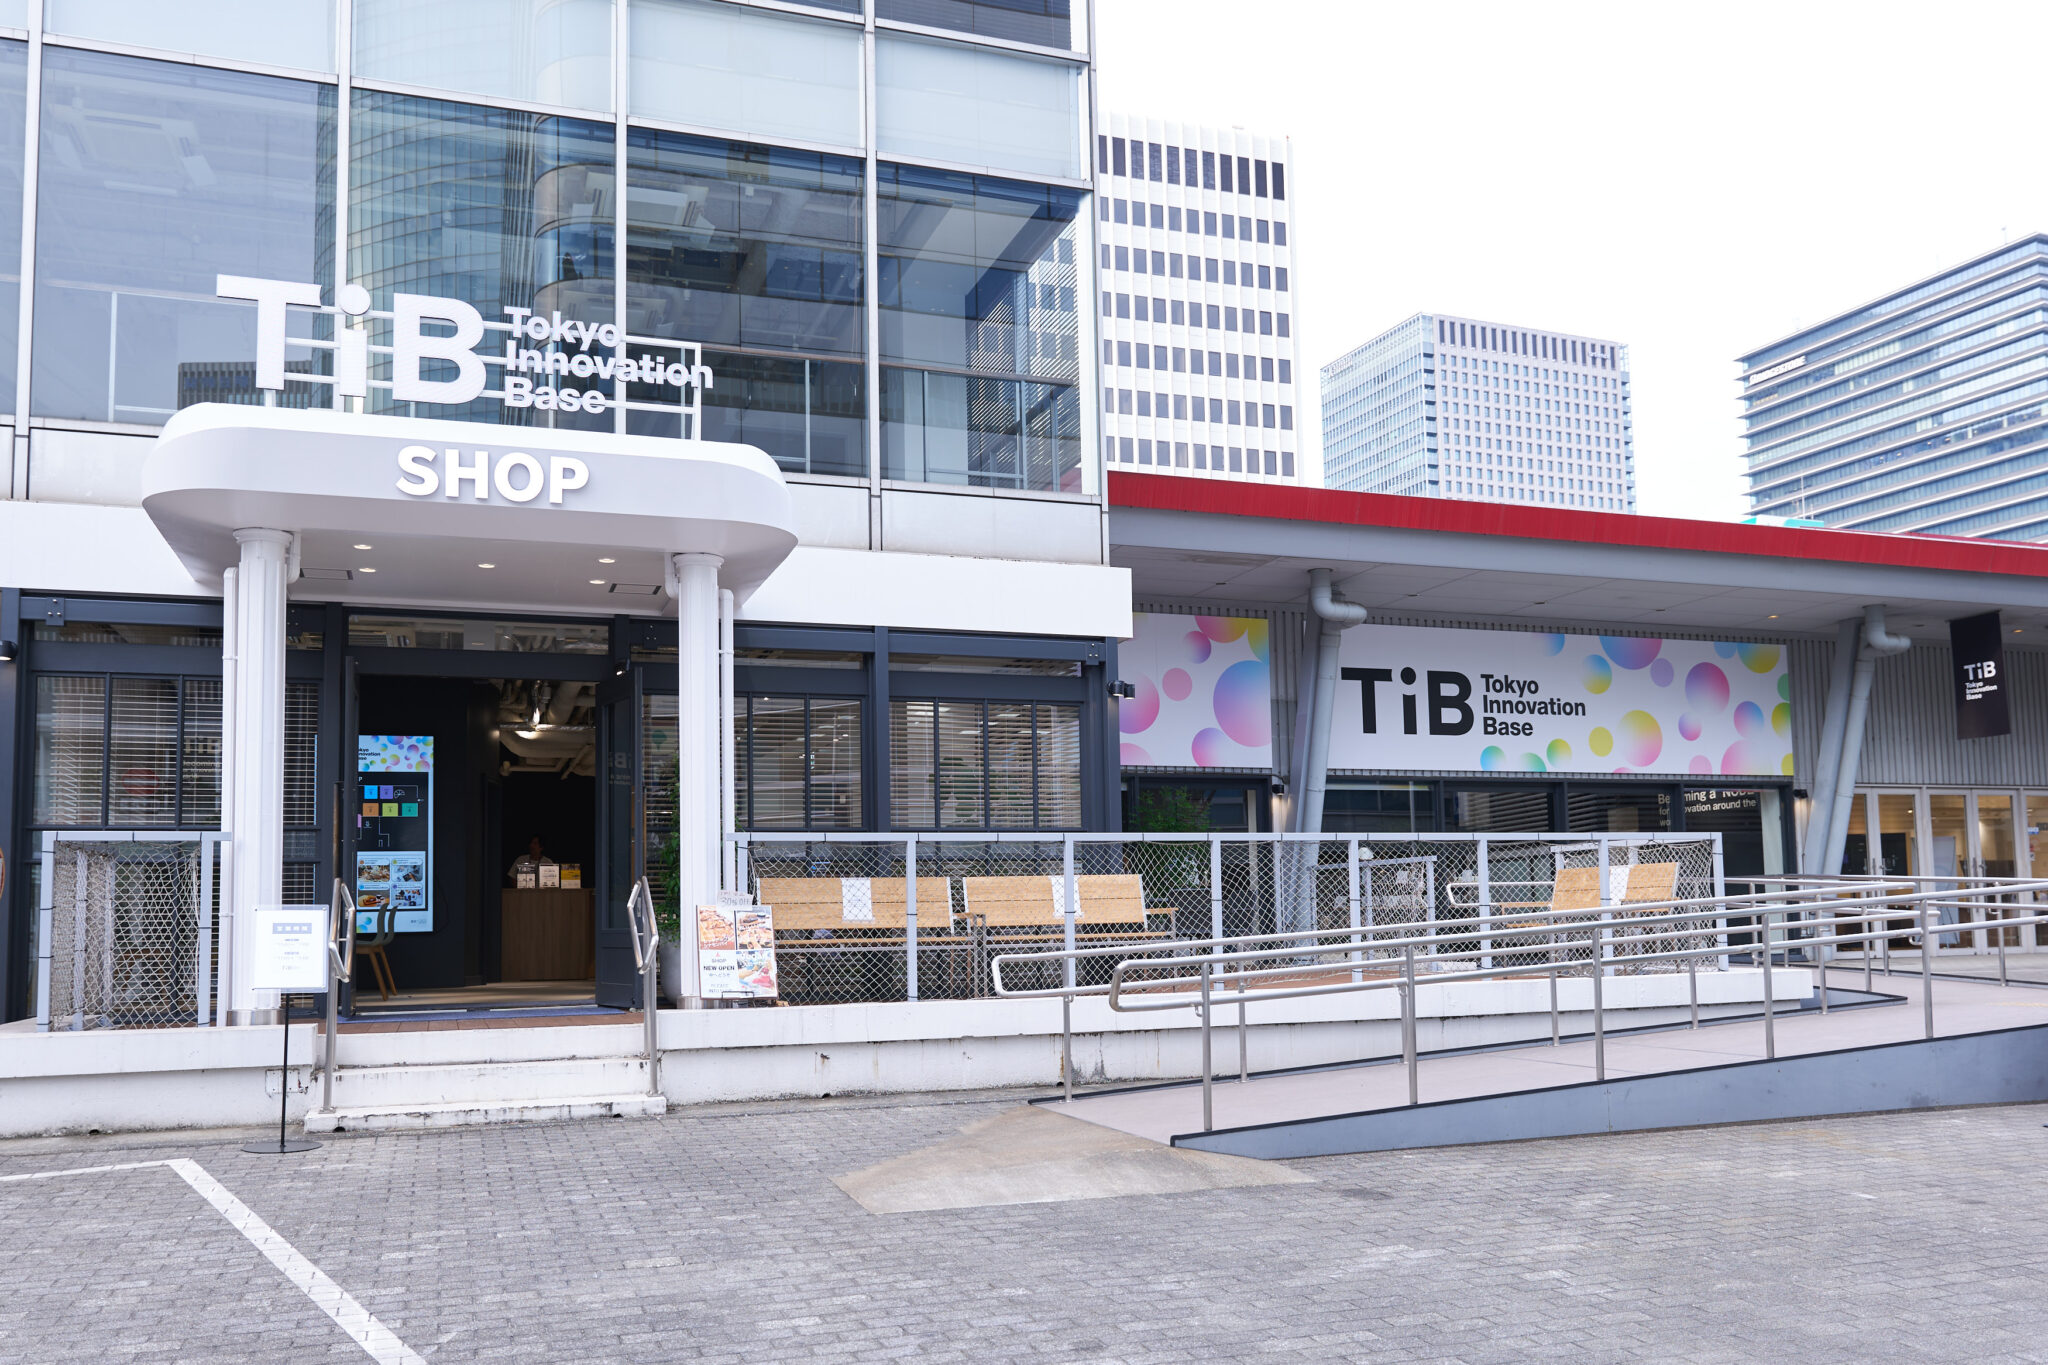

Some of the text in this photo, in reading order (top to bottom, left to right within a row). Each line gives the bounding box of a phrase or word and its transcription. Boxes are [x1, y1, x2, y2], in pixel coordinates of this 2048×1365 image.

[216, 274, 485, 405] TiB
[503, 306, 621, 352] Tokyo
[506, 339, 714, 389] Innovation
[503, 376, 608, 415] Base
[396, 445, 591, 505] SHOP
[1480, 673, 1539, 698] Tokyo
[1963, 661, 1997, 681] TiB
[1340, 667, 1475, 736] TiB
[1482, 694, 1586, 717] Innovation
[1482, 716, 1534, 736] Base
[1709, 789, 1717, 799] a
[1712, 799, 1741, 811] around
[1743, 798, 1757, 807] the
